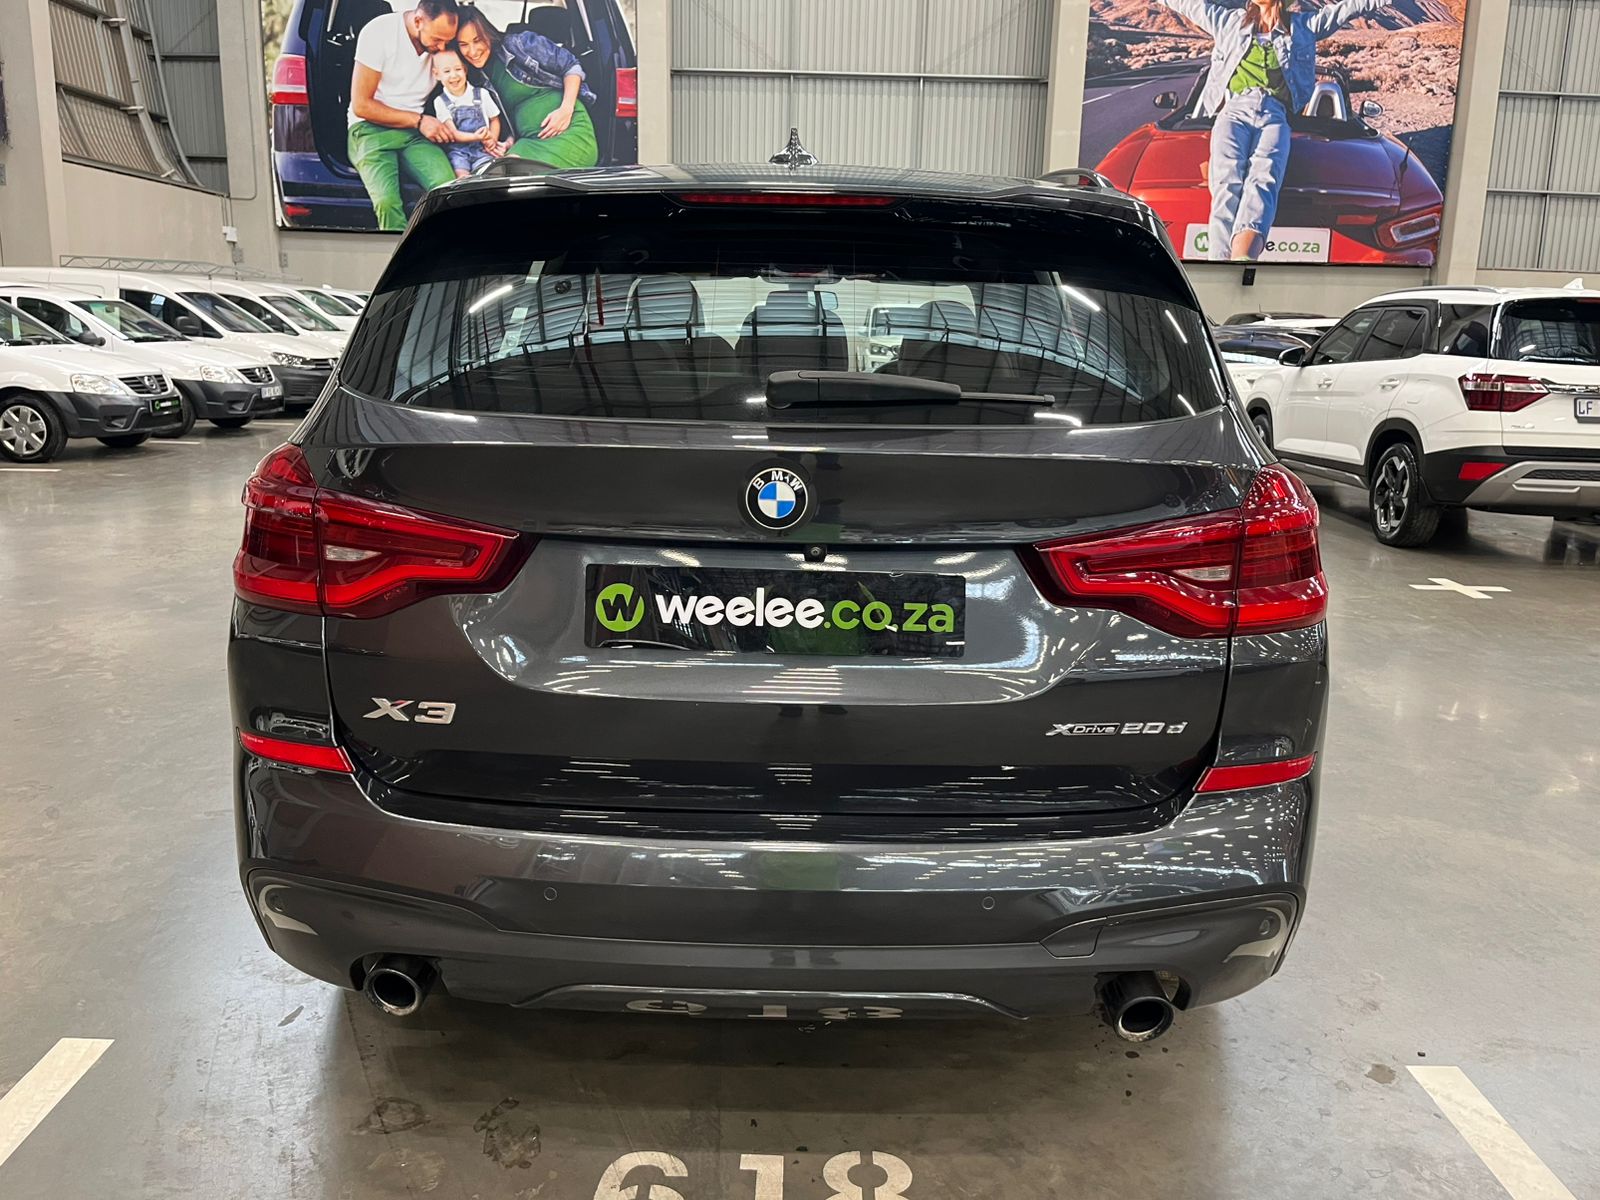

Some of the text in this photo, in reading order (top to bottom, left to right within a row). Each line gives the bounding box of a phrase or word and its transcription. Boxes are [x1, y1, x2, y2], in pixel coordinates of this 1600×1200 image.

[1264, 240, 1321, 254] e.co.za
[1578, 400, 1593, 415] LF
[752, 470, 803, 491] BMW
[655, 586, 955, 632] weelee.co.za
[362, 697, 456, 725] X3
